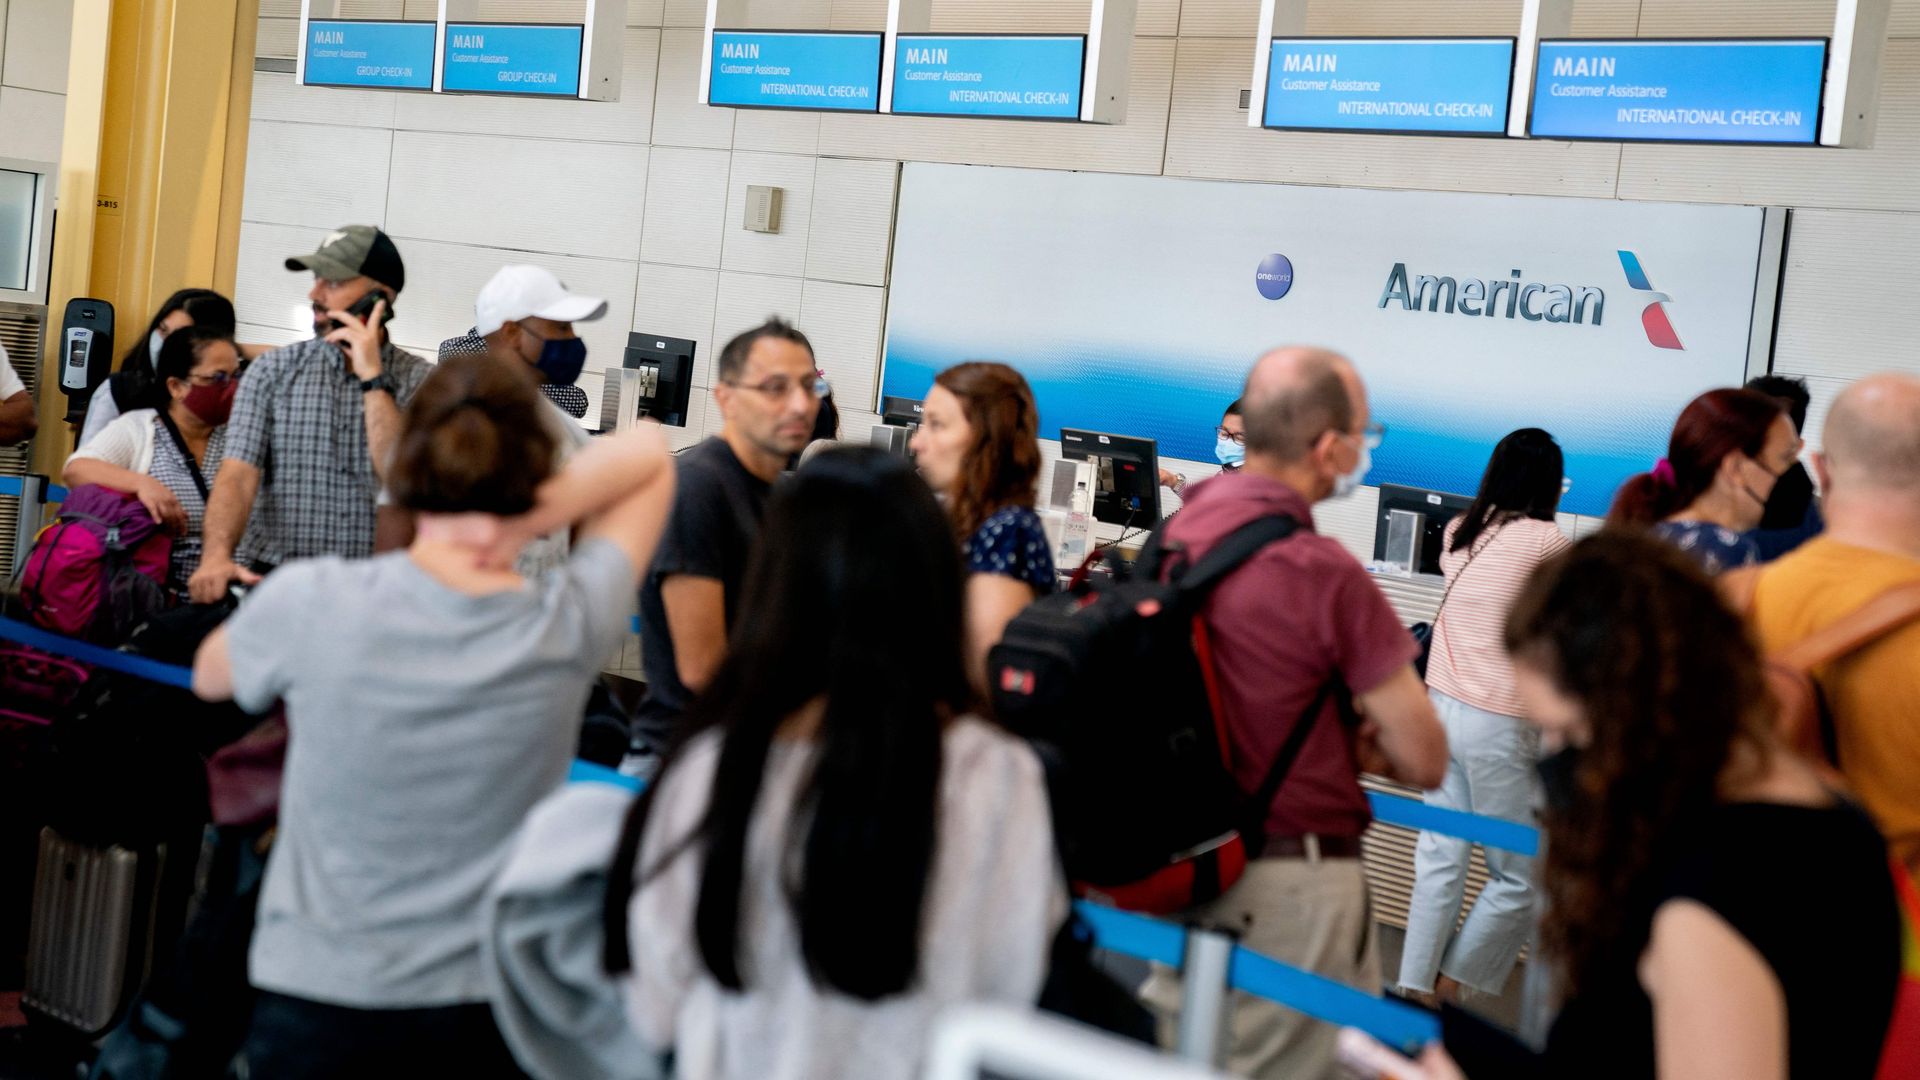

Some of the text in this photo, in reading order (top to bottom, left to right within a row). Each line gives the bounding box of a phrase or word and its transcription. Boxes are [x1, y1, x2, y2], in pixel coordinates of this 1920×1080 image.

[314, 31, 343, 44] MAIN
[453, 35, 484, 48] MAIN
[313, 48, 367, 59] Customer Assistance
[452, 52, 509, 64] Customer Assistance
[721, 43, 759, 59] MAIN
[906, 48, 948, 65] MAIN
[720, 63, 790, 76] Customer Assistance
[1283, 53, 1337, 72] MAIN
[1553, 57, 1616, 77] MAIN
[357, 66, 412, 78] GROUP CHECK-IN
[498, 71, 557, 83] GROUP CHECK-IN
[904, 69, 982, 82] Customer Assistance
[761, 83, 869, 98] INTERNATIONAL CHECK-IN
[1281, 77, 1380, 92] Customer Assistance
[1550, 83, 1667, 99] Customer Assistance
[949, 90, 1069, 105] INTERNATIONAL CHECK-IN
[1338, 101, 1493, 118] INTERNATIONAL CHECK-IN
[1617, 108, 1801, 126] INTERNATIONAL CHECK-IN
[1257, 272, 1290, 281] oneworld
[1377, 262, 1605, 326] American
